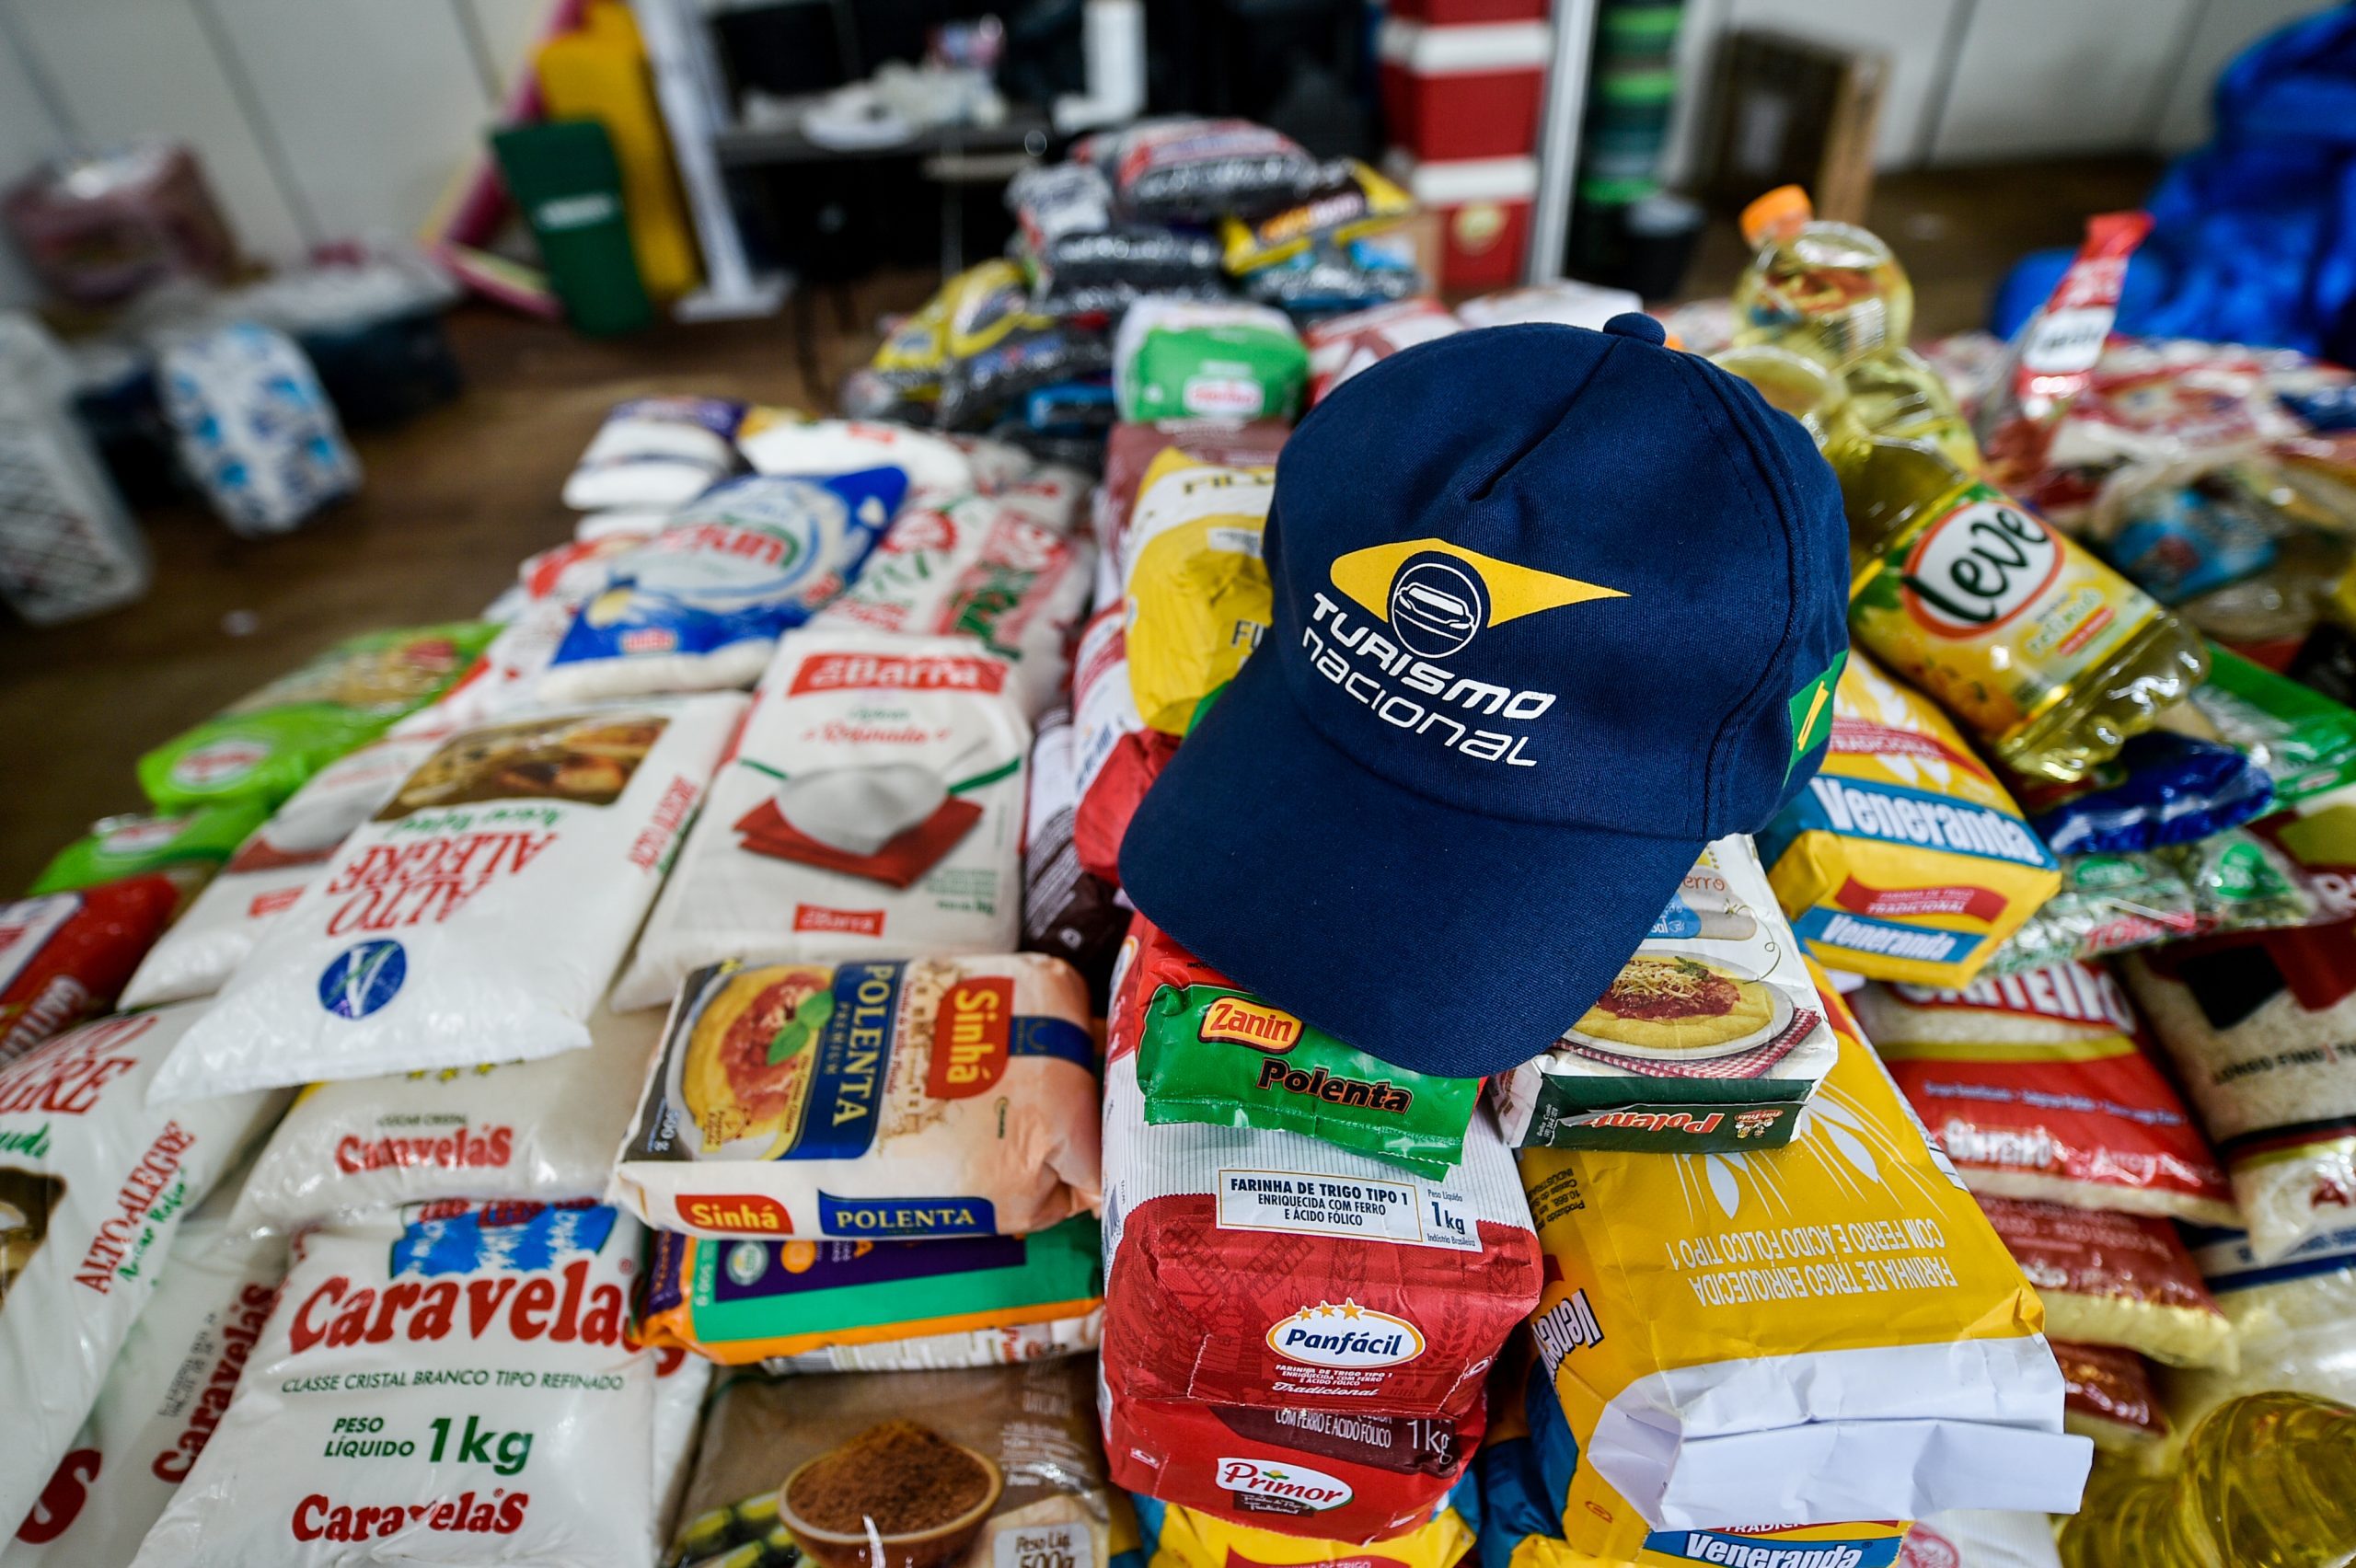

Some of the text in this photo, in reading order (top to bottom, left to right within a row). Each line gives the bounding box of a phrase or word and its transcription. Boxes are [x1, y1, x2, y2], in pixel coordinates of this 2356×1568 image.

[1311, 592, 1556, 720] TURISMO
[1811, 777, 2044, 865] Veneranda
[1683, 875, 1726, 892] erro
[1821, 914, 1958, 961] Veneranda
[1210, 1001, 1293, 1043] Zanin
[832, 964, 895, 1127] POLENTA
[946, 988, 999, 1084] Sinhá
[1256, 1056, 1415, 1114] Polenta
[1583, 1111, 1726, 1135] Polent
[1230, 1178, 1409, 1205] FARINHA DE TRIGO TIPO 1
[1257, 1193, 1386, 1216] ENRIQUECIDA COM FERRO
[1427, 1188, 1463, 1203] Peso Líquido
[689, 1202, 780, 1230] Sinhá
[836, 1207, 976, 1229] POLENTA
[1285, 1206, 1363, 1227] E ÁCIDO FÓLICO
[1431, 1201, 1466, 1235] 1 kg
[1426, 1232, 1450, 1244] Indústria
[1664, 1217, 1946, 1272] COM FERRO E ÁCIDO FÓLICO TIPO 1
[1687, 1256, 1958, 1307] FARINHA DE TRIGO ENRIQUECIDA
[1285, 1328, 1403, 1357] Panfácil
[282, 1369, 625, 1394] CLASSE CRISTAL BRANCO TIPO REFINADO
[1275, 1364, 1316, 1374] FARINHA
[1318, 1367, 1332, 1376] DE
[1334, 1369, 1362, 1378] TRIGO
[1281, 1370, 1334, 1381] ENRIQUECIDA
[1272, 1381, 1380, 1397] Tradicional
[332, 1416, 386, 1435] PESO
[1297, 1412, 1325, 1434] FERRO
[1325, 1418, 1332, 1435] E
[1333, 1414, 1360, 1442] ÁCIDO
[1360, 1422, 1392, 1448] FÓLICO
[324, 1435, 416, 1459] LÍQUIDO
[1224, 1461, 1344, 1504] Primor
[1016, 1534, 1046, 1555] Peso
[1685, 1532, 1864, 1568] Veneranda
